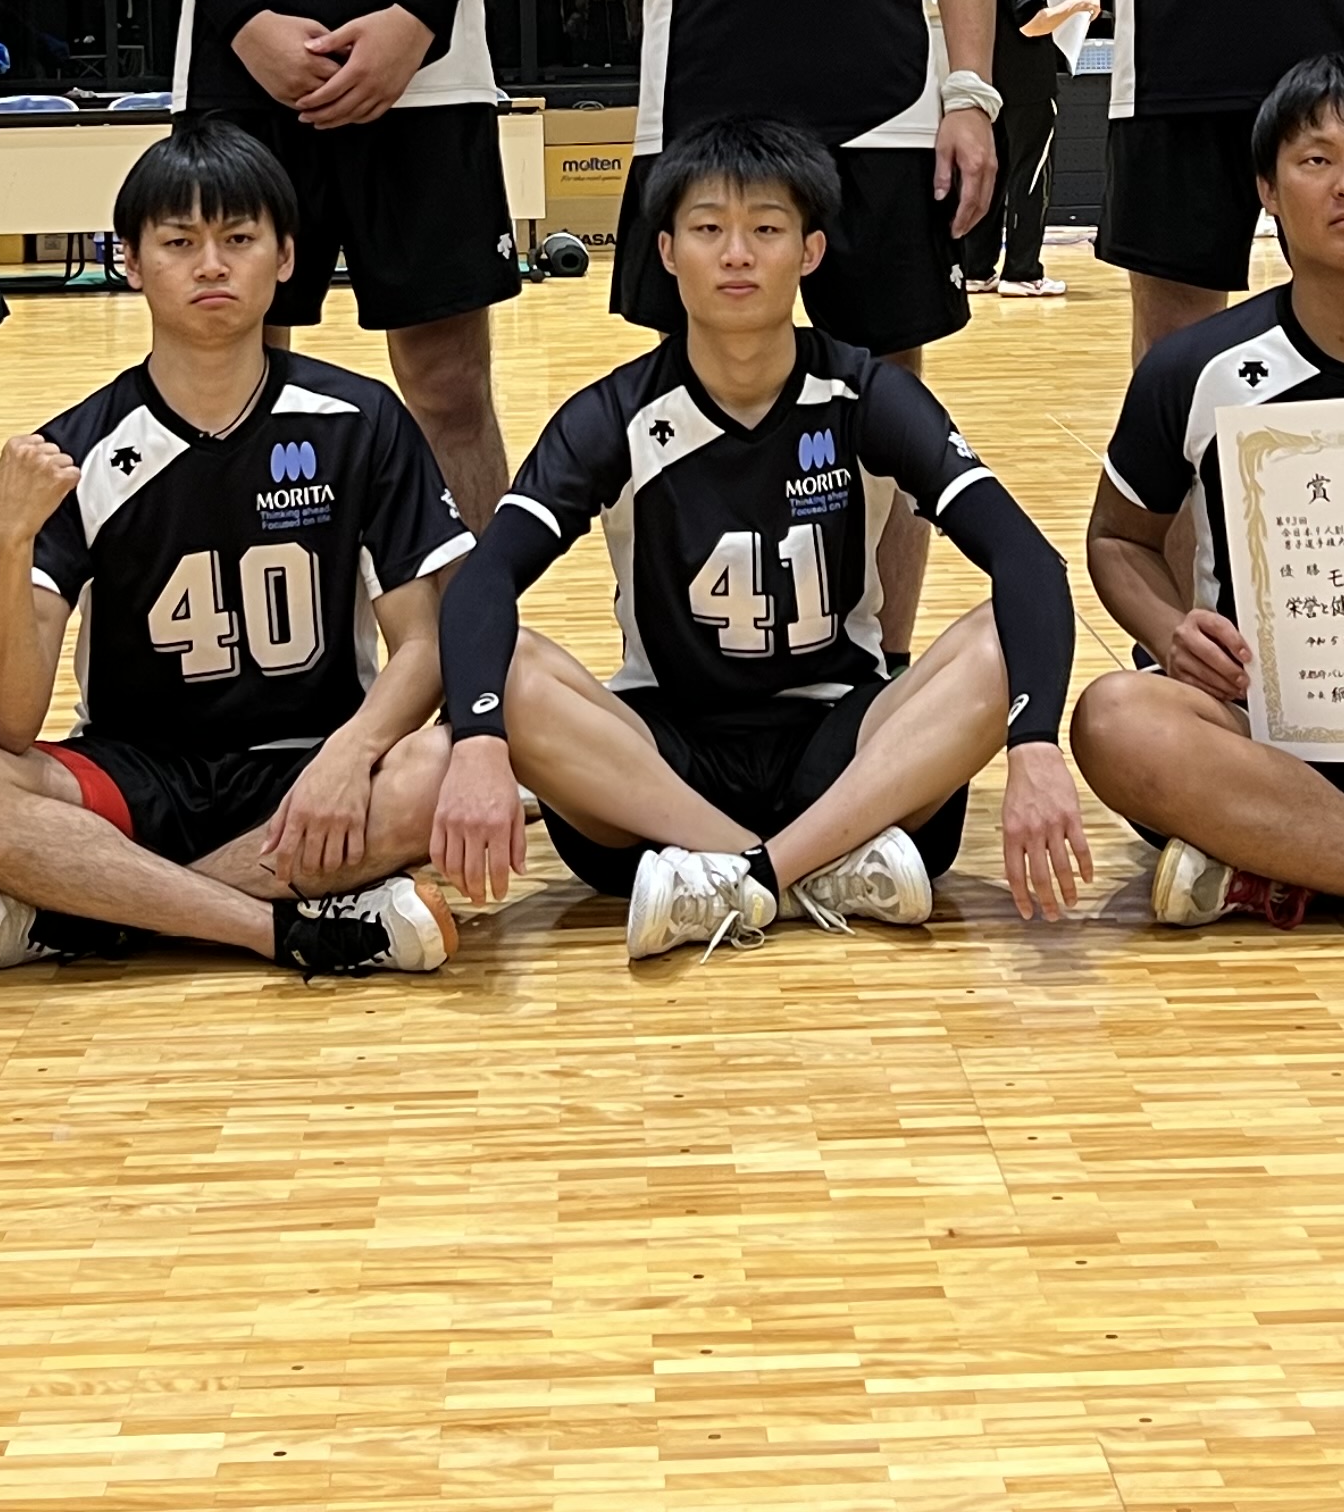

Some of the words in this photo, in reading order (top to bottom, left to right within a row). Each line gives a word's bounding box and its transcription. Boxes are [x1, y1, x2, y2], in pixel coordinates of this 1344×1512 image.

[562, 157, 622, 172] molten
[256, 484, 335, 511] MORITA
[148, 542, 325, 683] 40
[689, 523, 838, 658] 41
